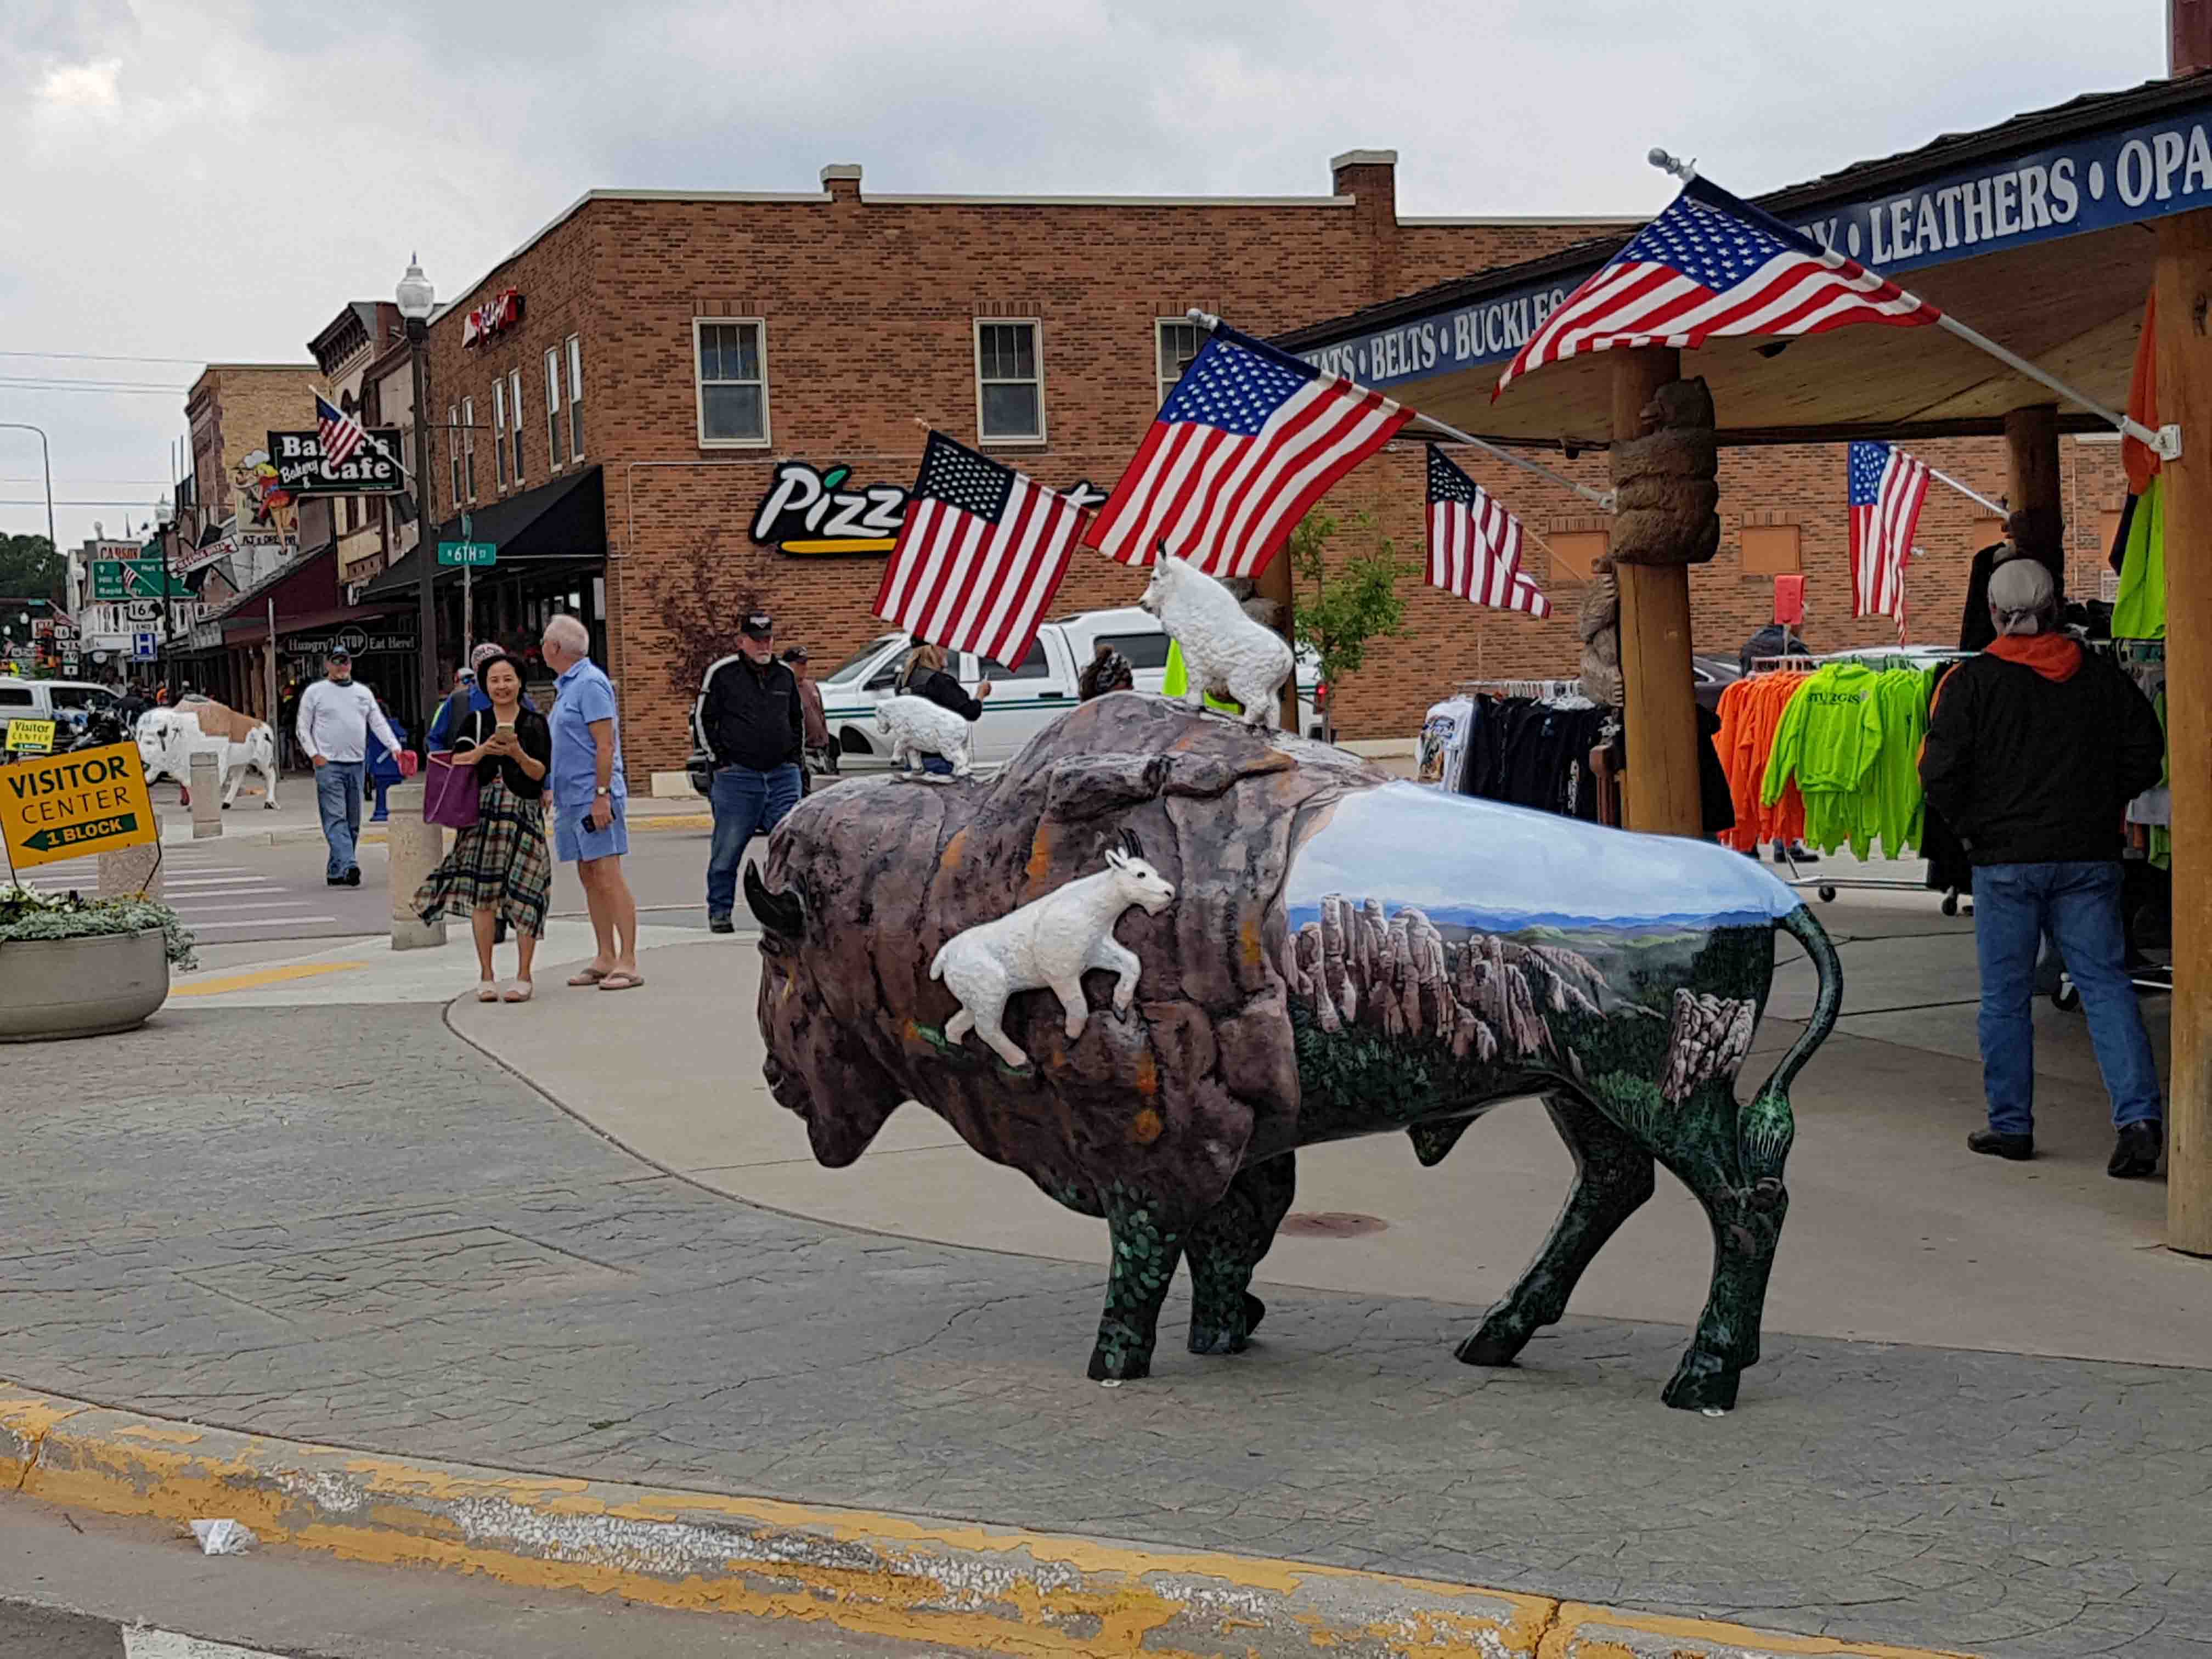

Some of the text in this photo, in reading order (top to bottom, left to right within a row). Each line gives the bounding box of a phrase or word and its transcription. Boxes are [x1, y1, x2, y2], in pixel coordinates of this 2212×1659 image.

[1869, 157, 2079, 266] LEATHERS
[1370, 323, 1436, 381] BELTS
[320, 457, 391, 480] Cafe
[755, 467, 906, 539] Pizz
[454, 546, 476, 561] 6TH
[136, 633, 153, 653] H
[289, 636, 334, 653] Hungry?
[340, 635, 364, 649] STOP
[369, 637, 385, 650] Eat
[1807, 692, 1861, 704] STURGIS
[8, 755, 130, 799] VISITOR
[22, 786, 131, 824] CENTER
[46, 818, 123, 845] 1 BLOCK
